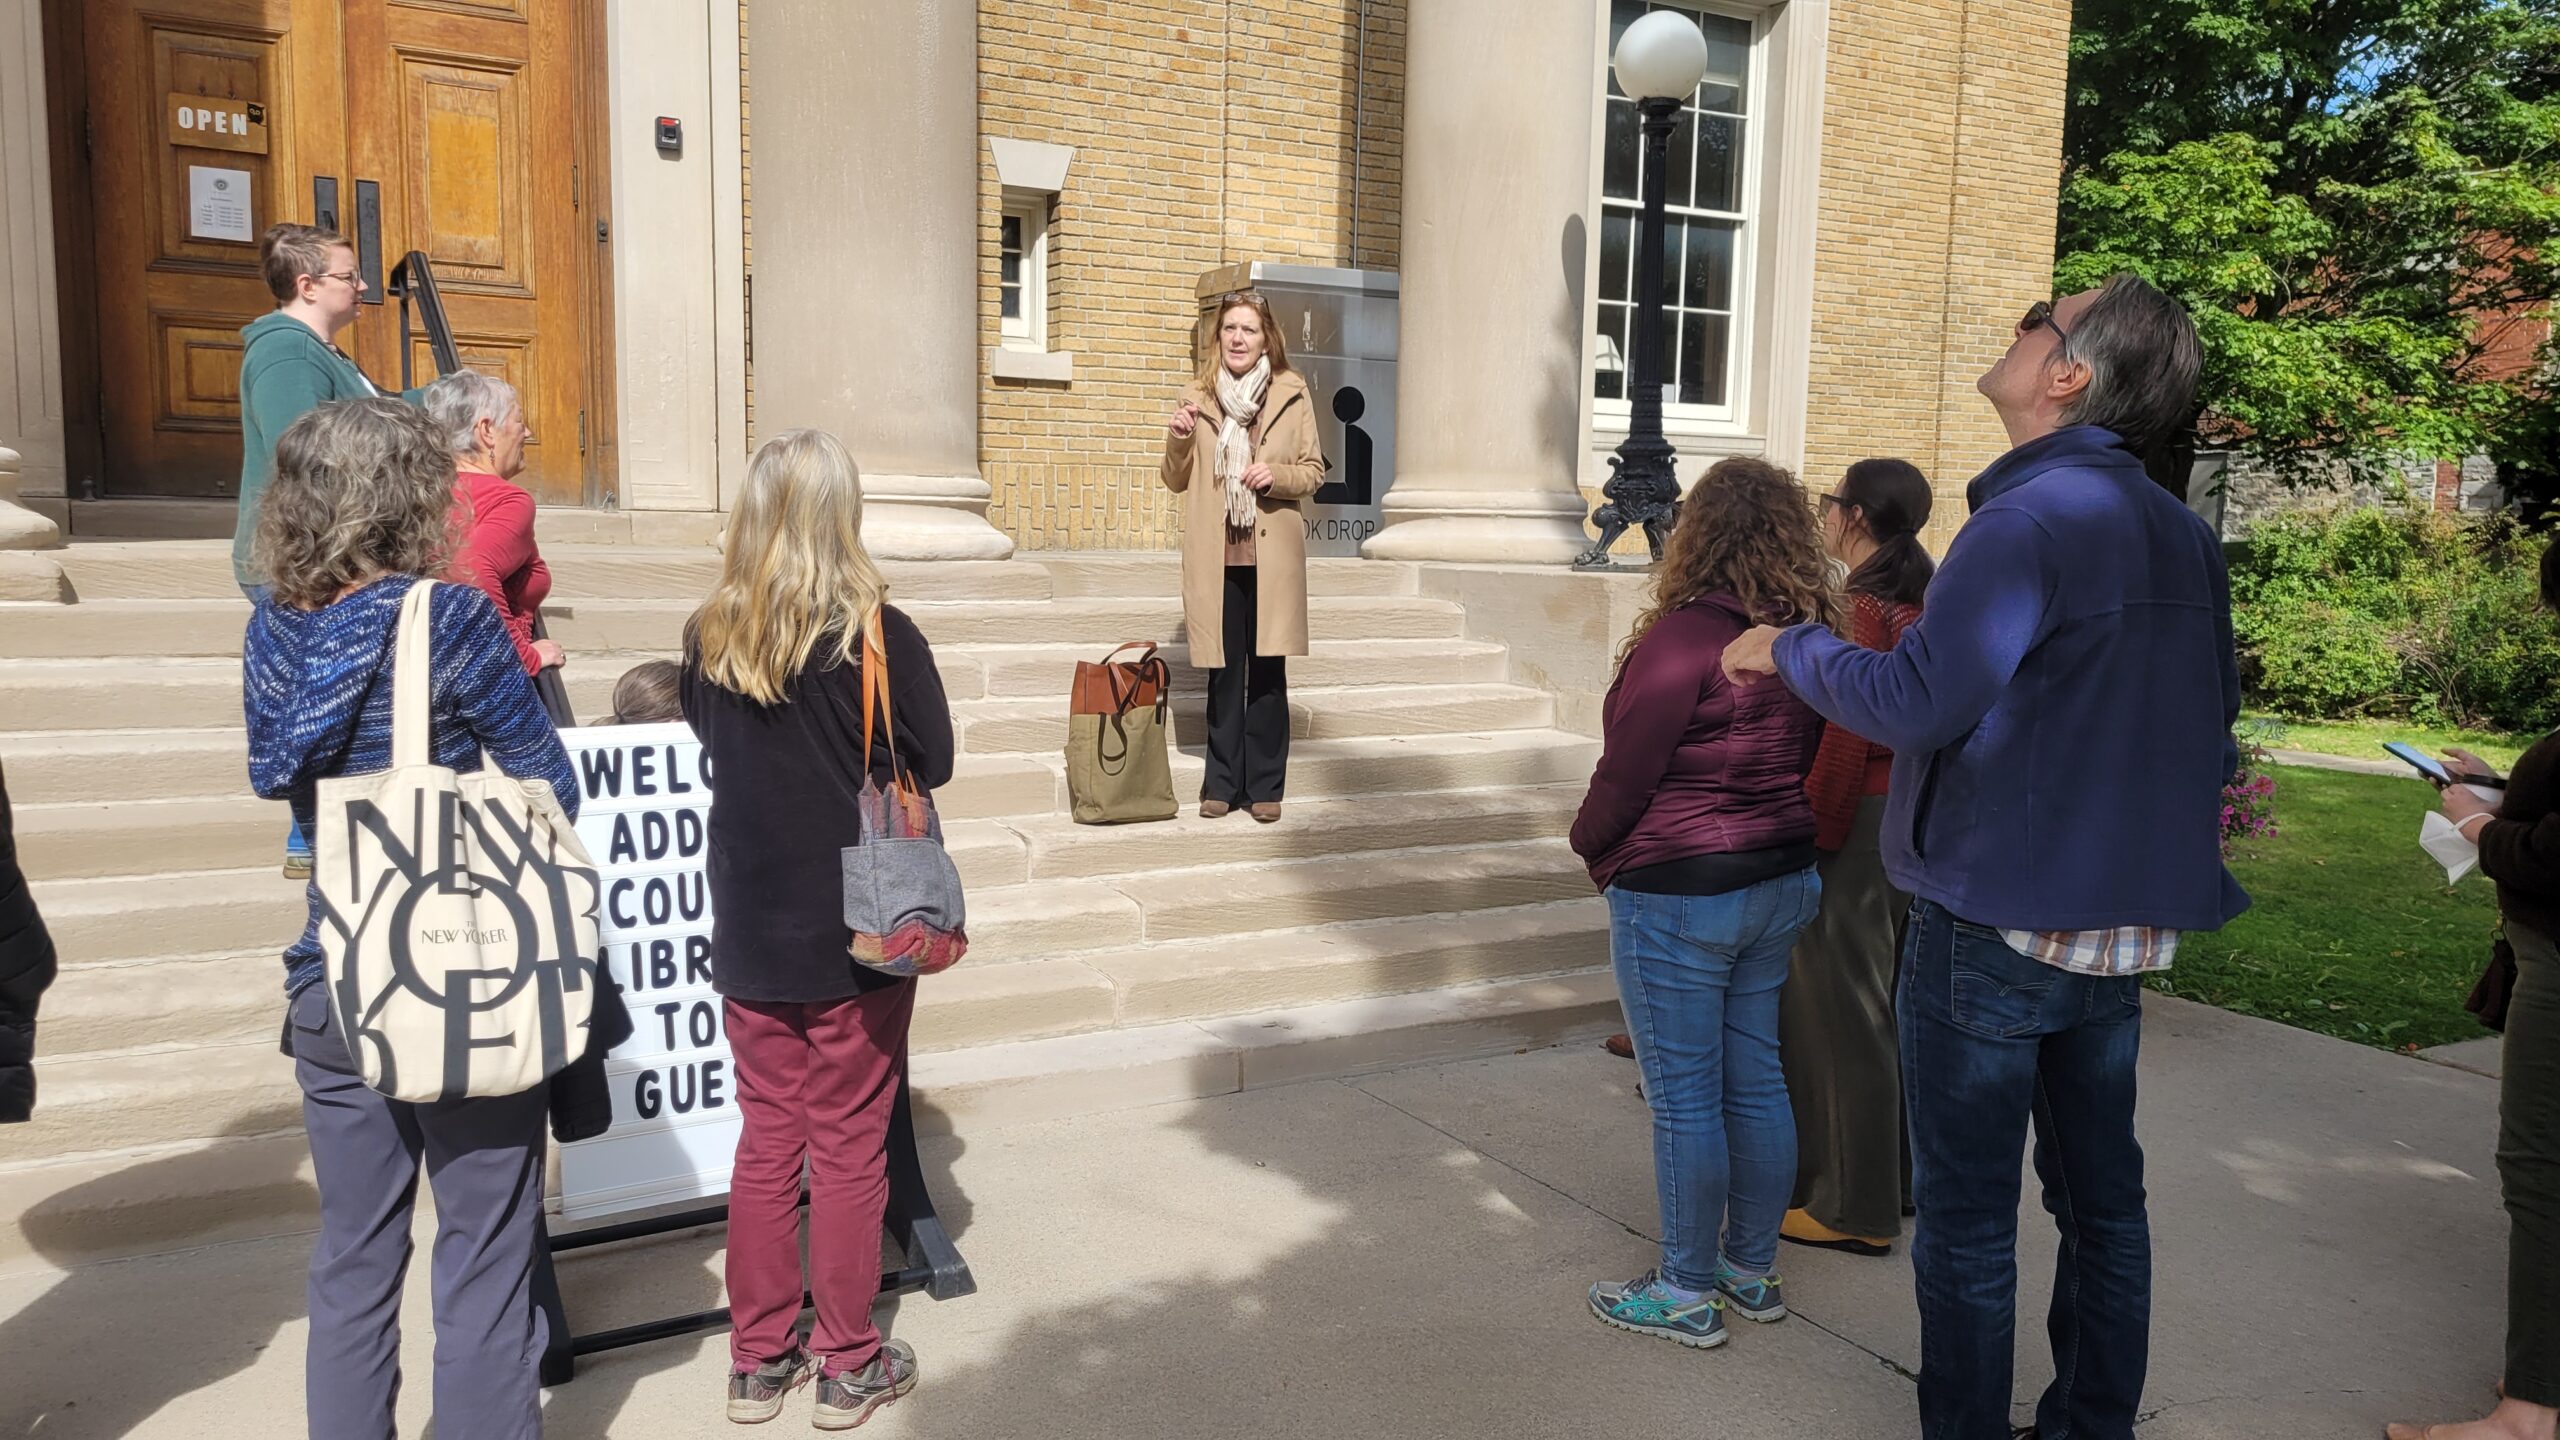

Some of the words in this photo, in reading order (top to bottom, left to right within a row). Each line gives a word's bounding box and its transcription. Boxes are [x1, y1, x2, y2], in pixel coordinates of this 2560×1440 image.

[178, 106, 248, 136] OPEN
[1327, 519, 1375, 541] DROP
[609, 808, 702, 865] ADD
[608, 871, 703, 930] COU
[421, 928, 460, 945] NEW
[461, 928, 509, 946] YOKER
[654, 996, 729, 1052] TO
[635, 1059, 738, 1120] GUE
